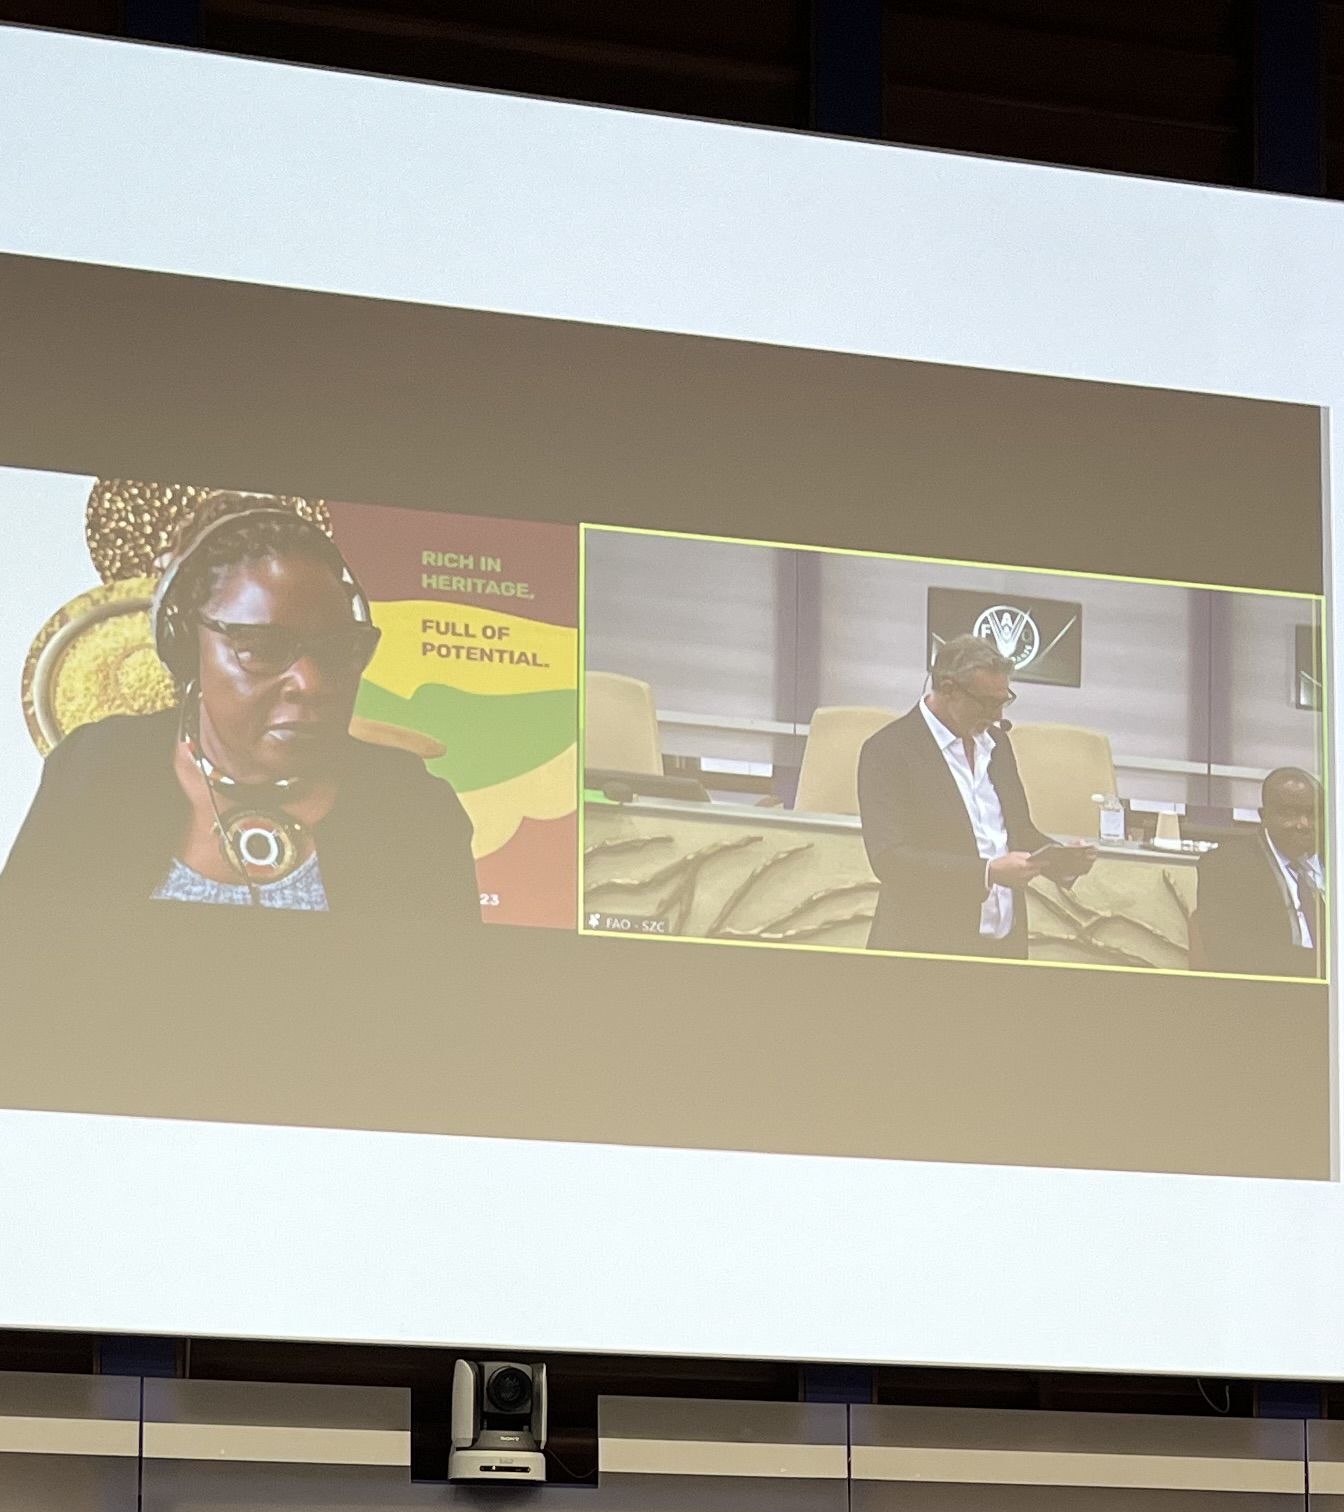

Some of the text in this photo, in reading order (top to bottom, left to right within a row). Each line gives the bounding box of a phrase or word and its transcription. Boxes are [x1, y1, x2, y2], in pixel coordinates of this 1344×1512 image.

[421, 550, 502, 573] RICH IN
[421, 573, 535, 600] HERITAGE.
[421, 618, 510, 641] FULL OF
[421, 642, 550, 668] POTENTIAL.
[605, 918, 631, 930] FAO
[641, 920, 666, 933] SZC
